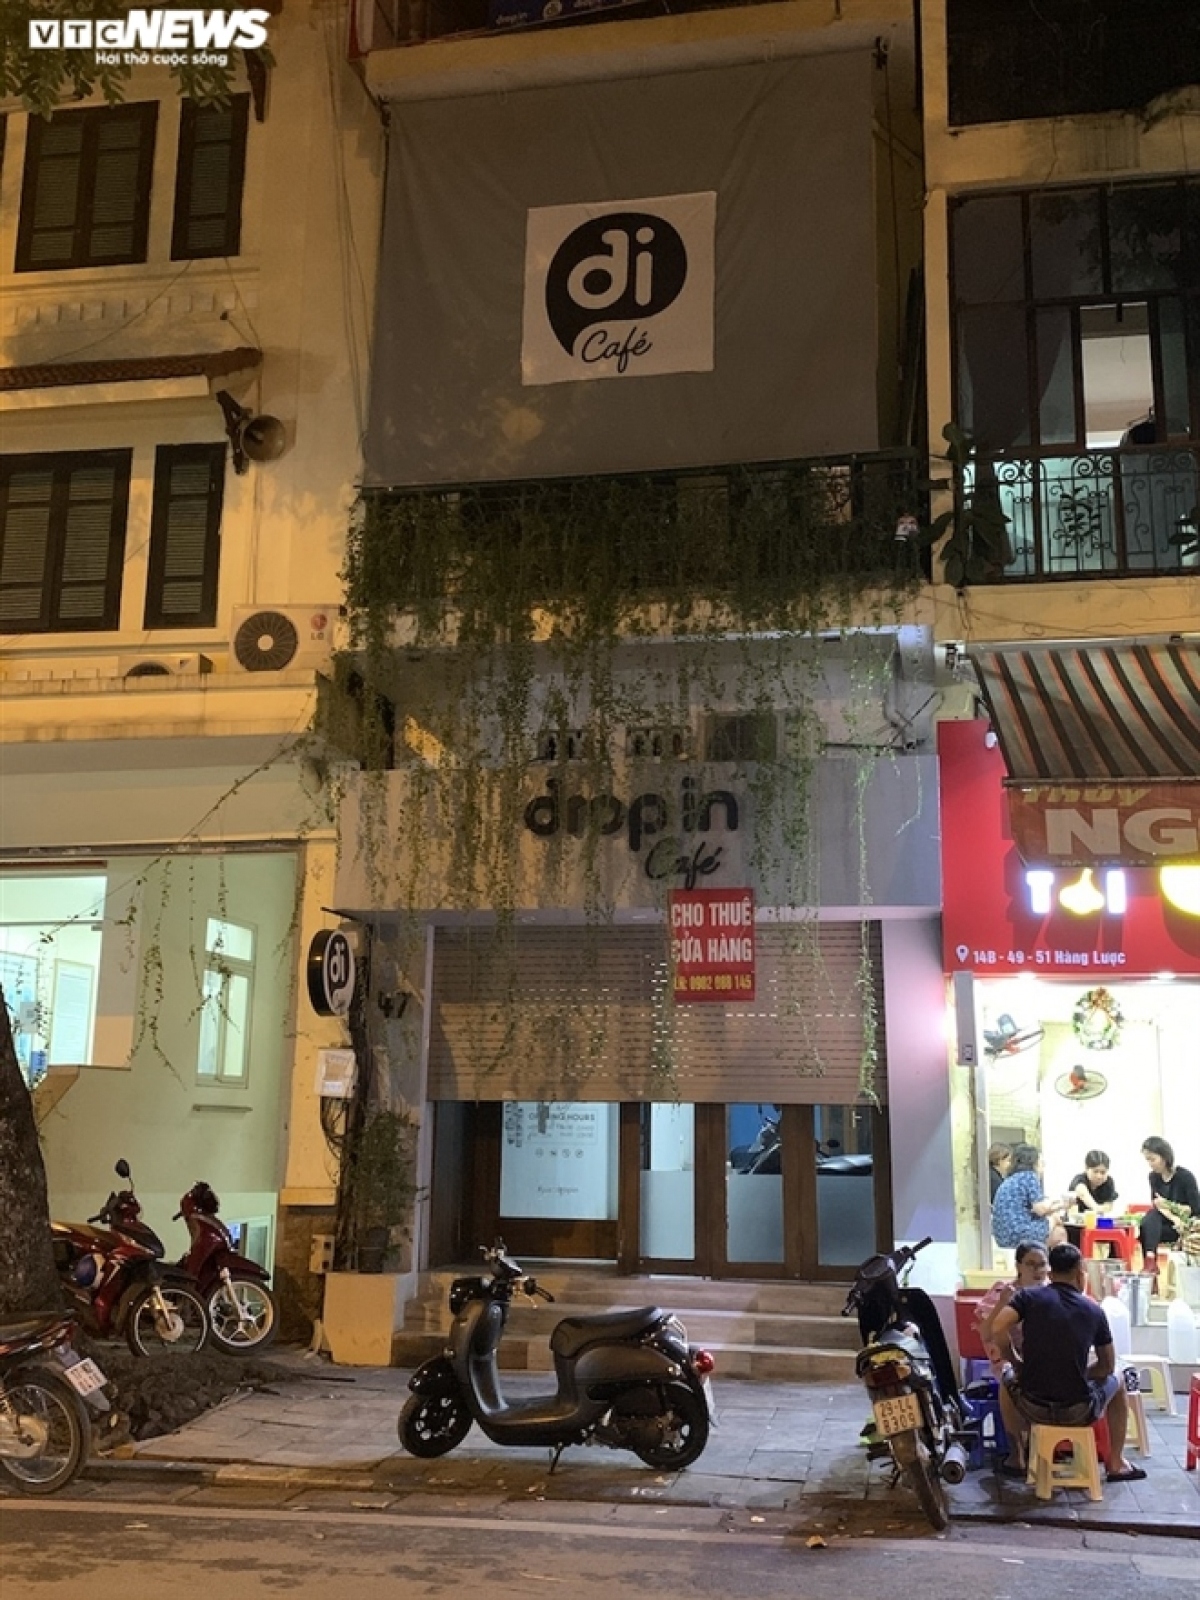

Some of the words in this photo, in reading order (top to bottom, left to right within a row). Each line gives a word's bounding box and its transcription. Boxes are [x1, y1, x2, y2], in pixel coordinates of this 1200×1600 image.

[567, 226, 655, 310] di
[581, 326, 653, 373] Café
[1045, 808, 1200, 855] NG
[671, 903, 704, 927] CHO
[709, 896, 752, 927] THUÊ
[671, 931, 703, 963] CỬA
[708, 933, 752, 963] HÀNG
[973, 950, 997, 964] 14B
[1006, 950, 1025, 964] 49
[1035, 950, 1050, 964] 51
[1054, 949, 1089, 966] Hàng
[378, 991, 414, 1019] 47
